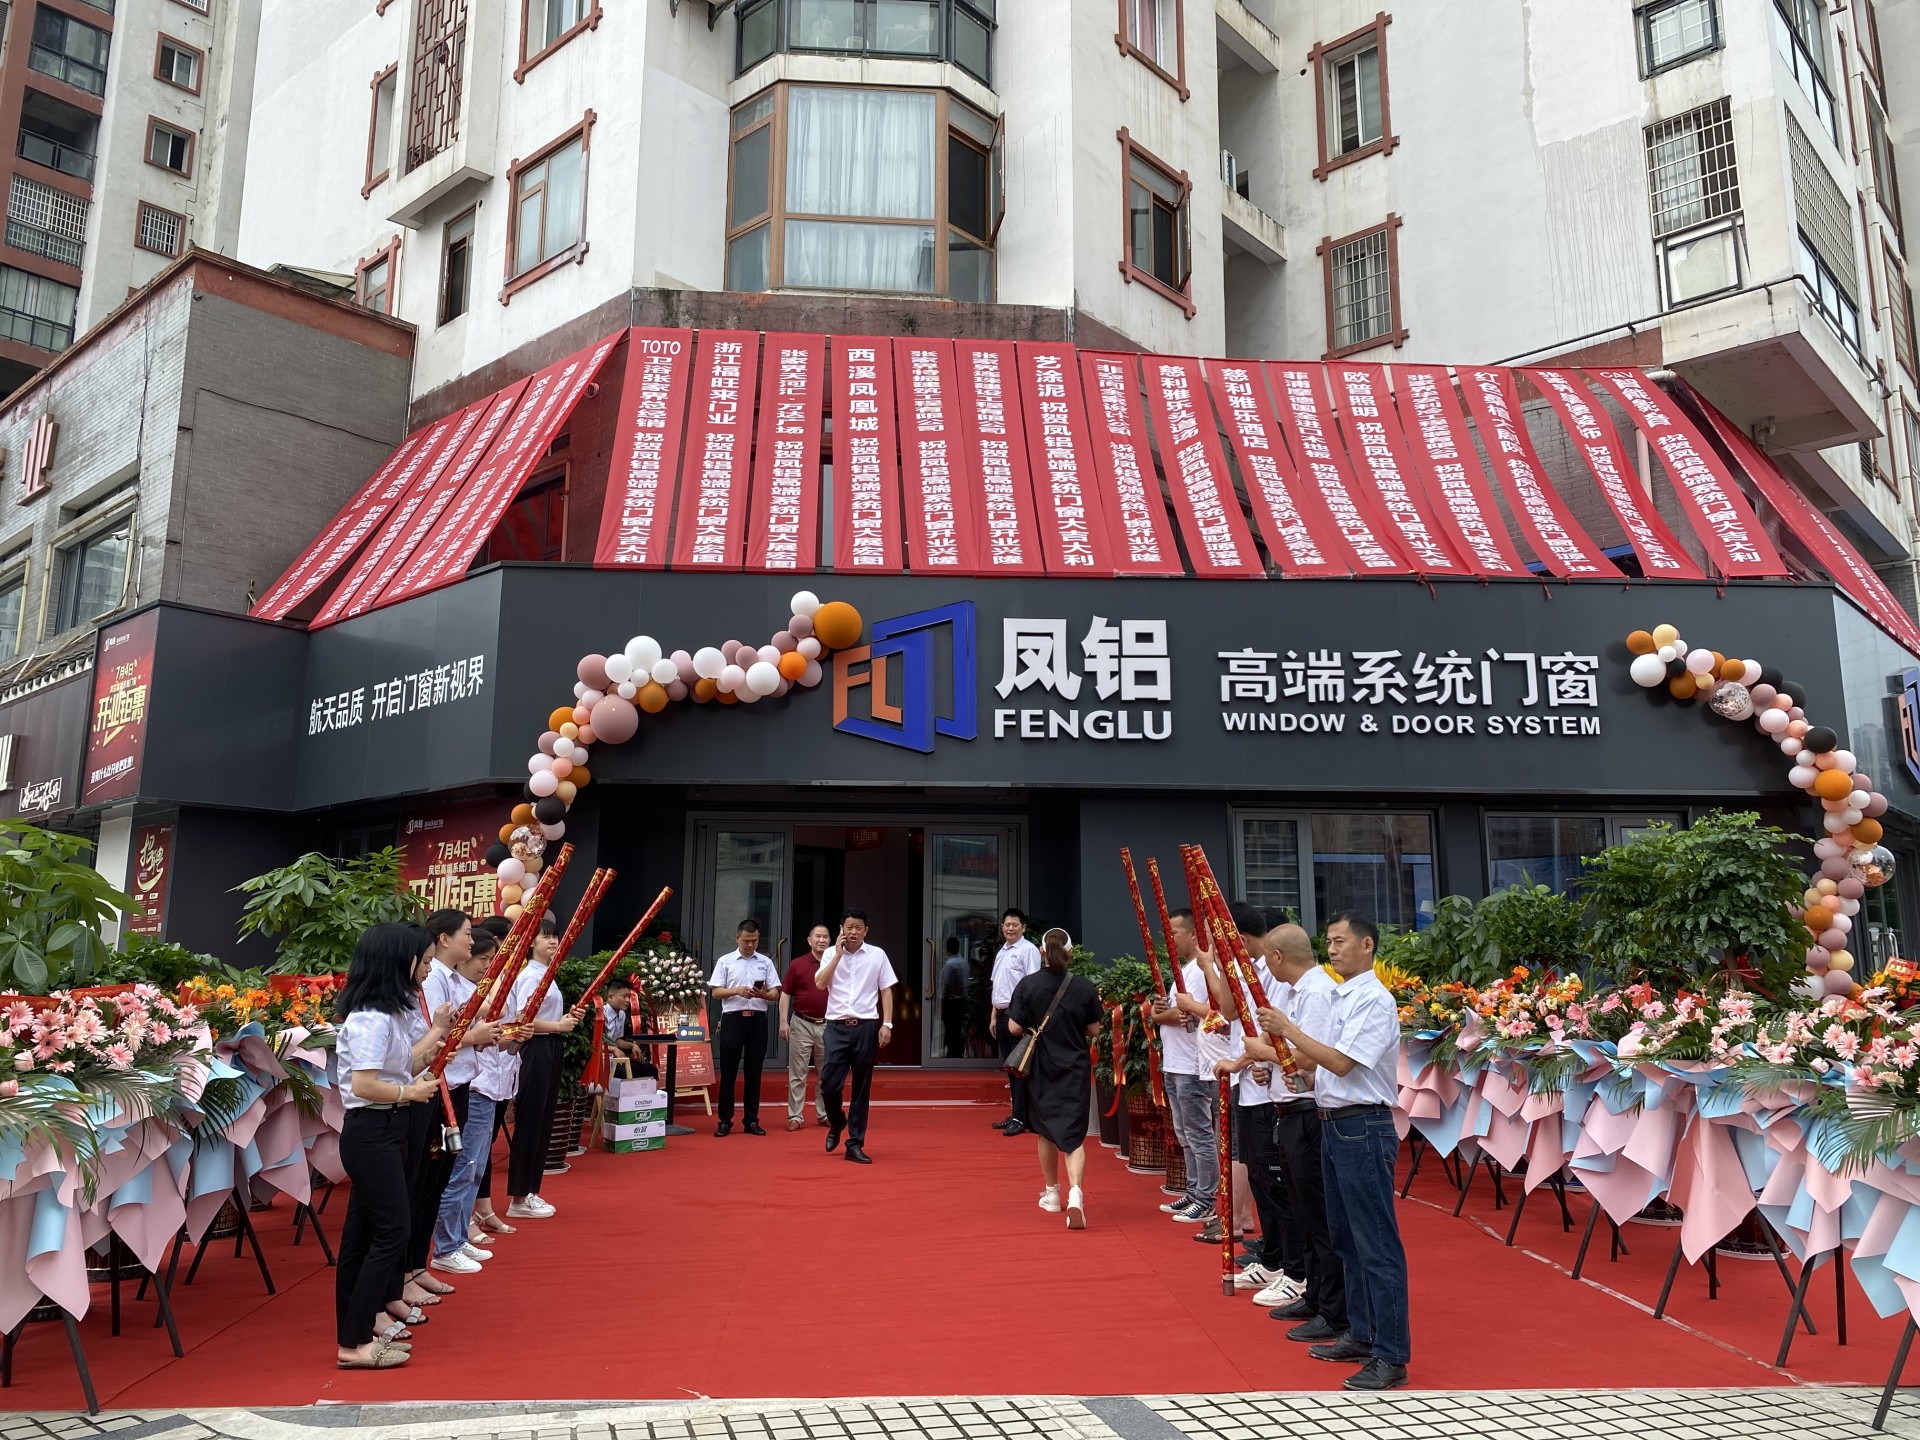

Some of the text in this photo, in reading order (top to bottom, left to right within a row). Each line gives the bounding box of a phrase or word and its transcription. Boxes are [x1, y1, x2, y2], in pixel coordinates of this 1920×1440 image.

[614, 339, 681, 563] TOTO 卫浴张家界总经销 祝贺凤铝高端系统门窗大吉大利
[692, 342, 742, 563] 浙江福旺来门业 祝贺凤铝高端系统门窗大展宏图
[848, 348, 884, 566] 西溪凤凰城 祝贺凤铝高端系统门窗大展宏图
[1034, 355, 1094, 566] 艺涂泥 祝贺凤铝高端系统门窗大吉大利
[1158, 365, 1242, 567] 慈利雅乐头道汤 祝贺凤铝高端系统门窗财源滚滚
[1221, 368, 1269, 450] 慈利雅乐酒店
[1343, 371, 1453, 568] 欧普照明 祝贺凤铝高端系统门窗开业大吉
[766, 441, 804, 569] 祝贺凤铝高端系统门窗大展宏图
[918, 440, 959, 565] 祝贺凤铝高端系统门窗开业兴隆
[980, 440, 1024, 565] 祝贺凤铝高端系统门窗开业兴隆
[1110, 442, 1163, 563] 祝贺凤铝高端系统门窗开业兴隆
[1657, 432, 1762, 563] 祝贺凤铝高端系统门窗大吉大利
[116, 663, 134, 680] 7月4日
[308, 655, 485, 736] 航天品质 开启门窗新视界
[994, 615, 1172, 701] 凤铝
[1217, 647, 1599, 707] 高端系统门窗
[994, 709, 1172, 740] FENGLU
[1222, 712, 1601, 735] WINDOW & DOOR SYSTEM
[428, 860, 478, 875] 凤铝高端系统门窗
[438, 840, 470, 860] 7月4日
